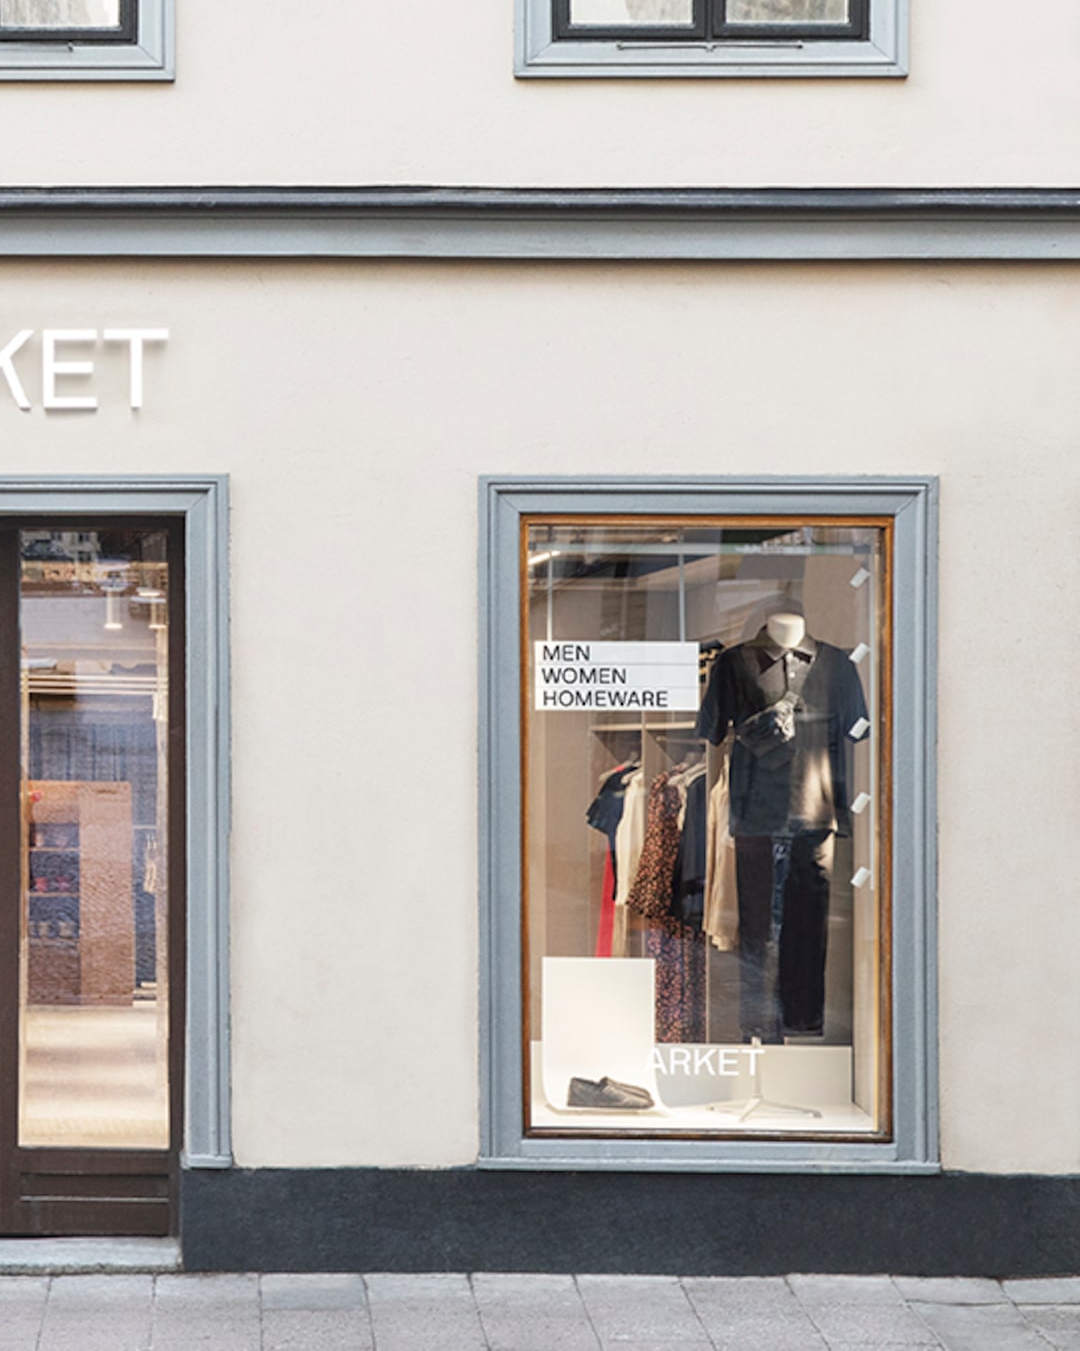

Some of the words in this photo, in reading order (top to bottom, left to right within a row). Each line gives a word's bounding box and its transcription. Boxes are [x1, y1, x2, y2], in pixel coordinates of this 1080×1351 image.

[543, 645, 590, 661] MEN
[542, 668, 627, 684] WOMEN
[542, 690, 669, 707] HOMEWARE
[643, 1047, 765, 1076] ARKET
